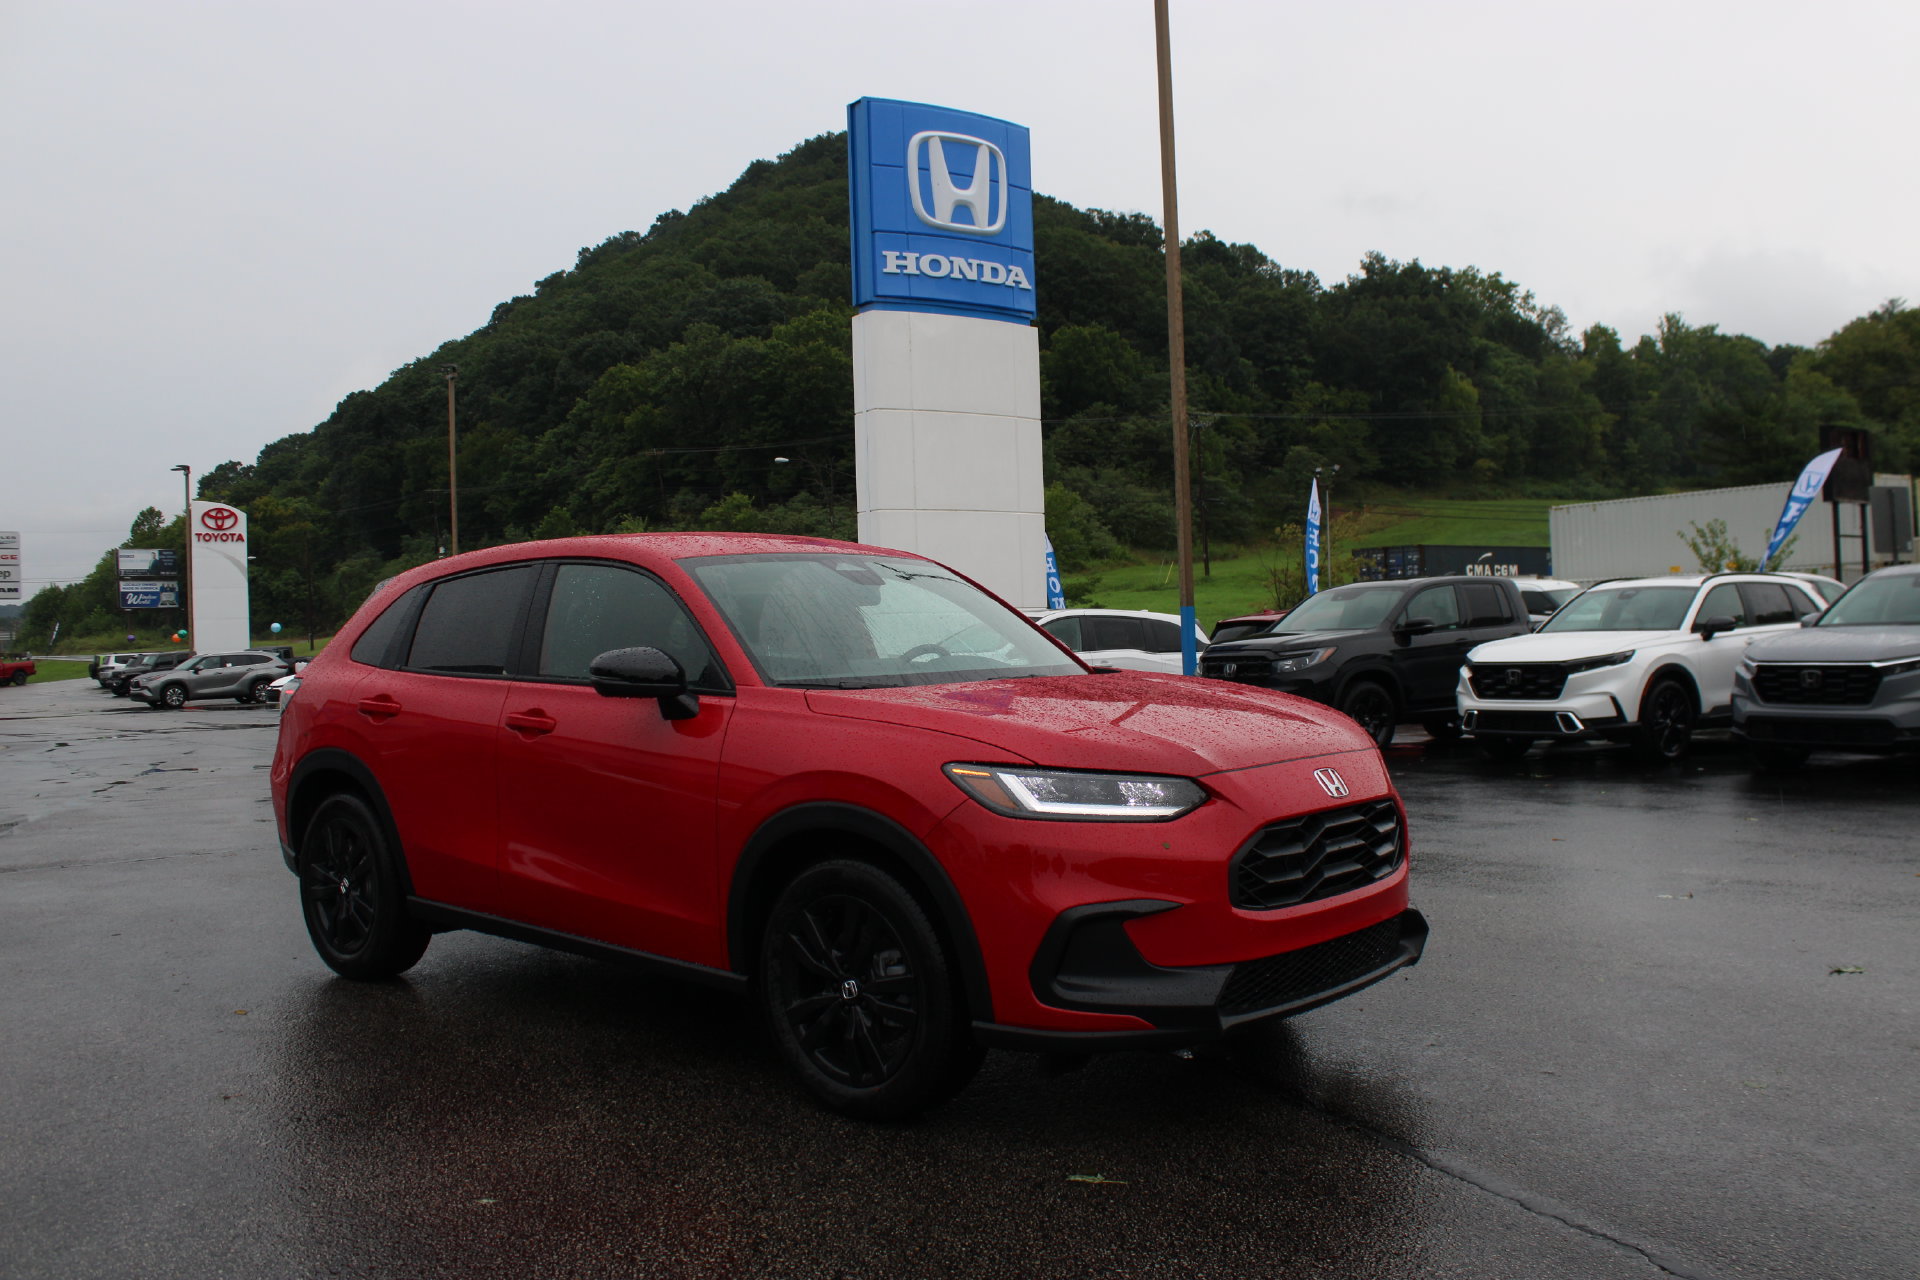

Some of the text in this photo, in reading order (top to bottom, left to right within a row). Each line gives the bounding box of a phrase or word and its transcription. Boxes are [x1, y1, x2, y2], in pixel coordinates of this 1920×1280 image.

[882, 250, 1032, 290] HONDA
[195, 532, 245, 542] TOYOTA
[1466, 564, 1519, 576] CMA CGM
